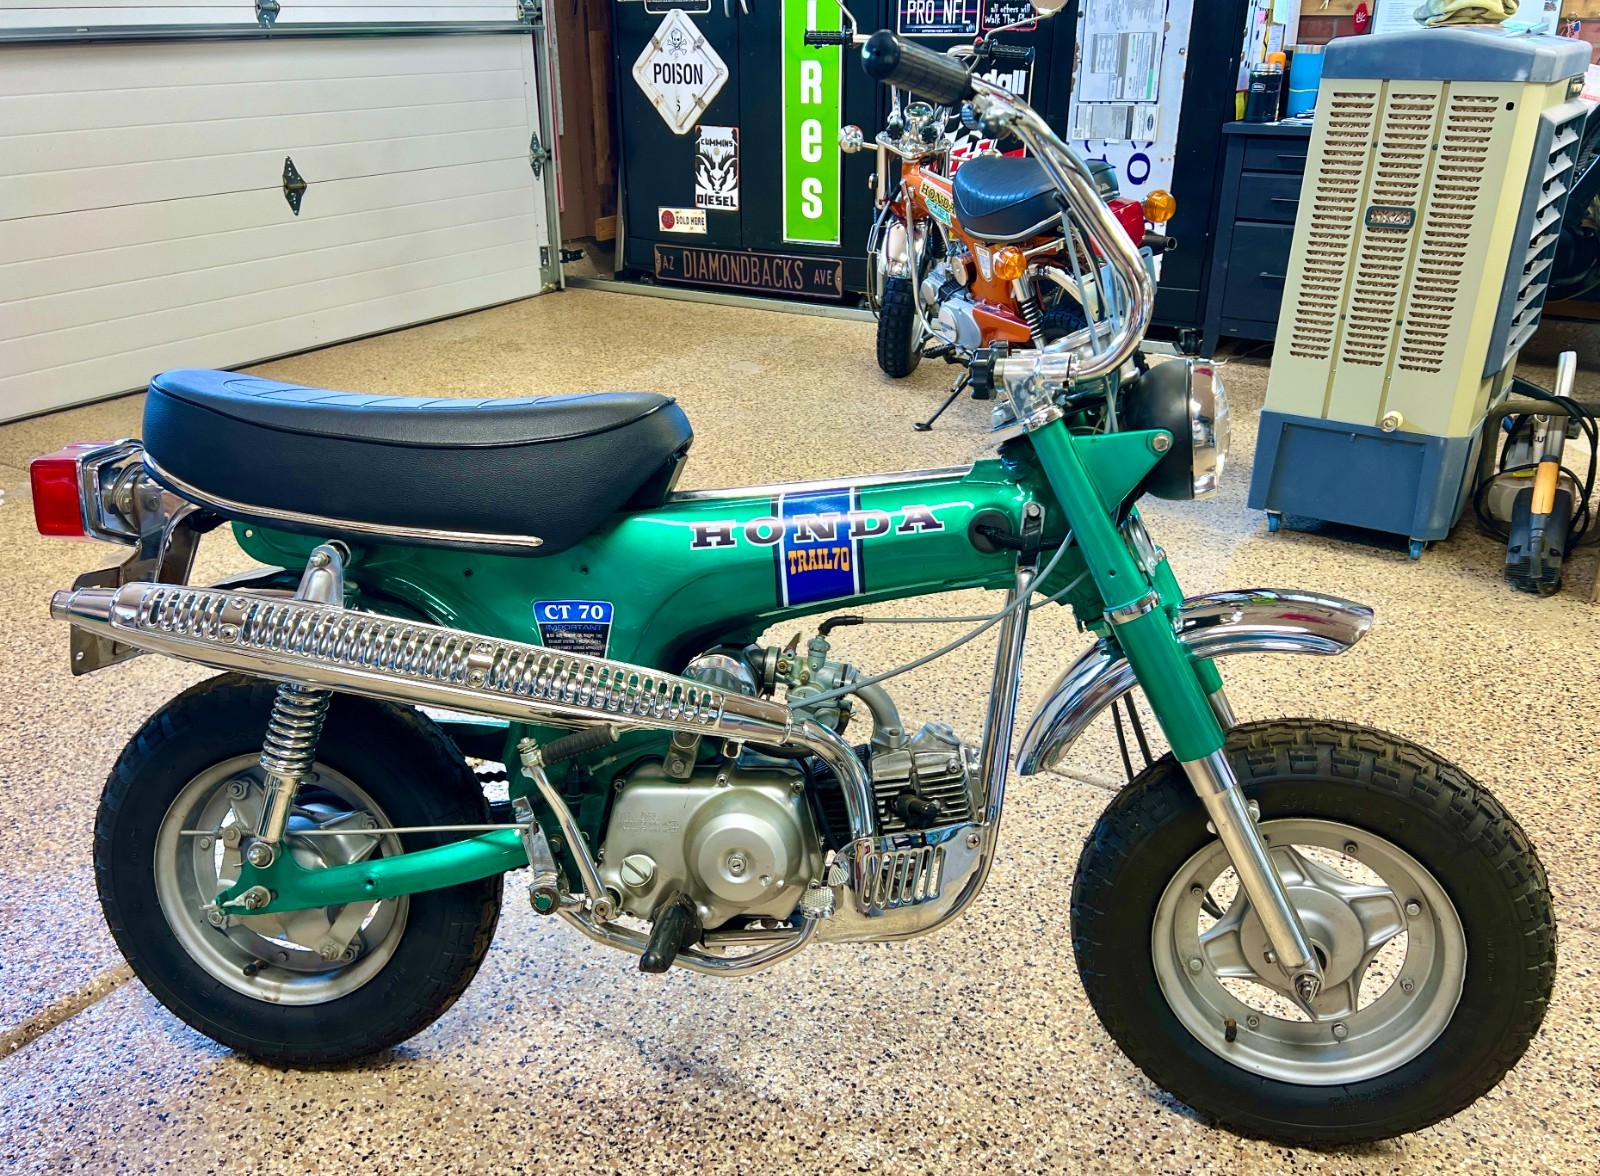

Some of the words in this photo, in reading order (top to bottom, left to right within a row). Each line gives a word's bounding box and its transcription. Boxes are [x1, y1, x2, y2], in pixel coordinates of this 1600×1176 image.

[906, 0, 935, 24] PRO
[942, 0, 971, 24] NFL
[985, 13, 1000, 25] Walk
[1002, 14, 1016, 24] The
[653, 62, 703, 85] POISON
[700, 138, 734, 147] CUMMINS
[696, 193, 738, 207] DIESEL
[921, 183, 956, 215] HONDA
[676, 216, 690, 225] SOLD
[690, 216, 705, 226] HERE
[662, 255, 675, 270] AZ
[682, 250, 804, 290] DIAMONDBACKS
[813, 269, 833, 286] AVE
[690, 505, 944, 550] HONDA
[544, 604, 572, 620] CT
[578, 604, 604, 620] 70
